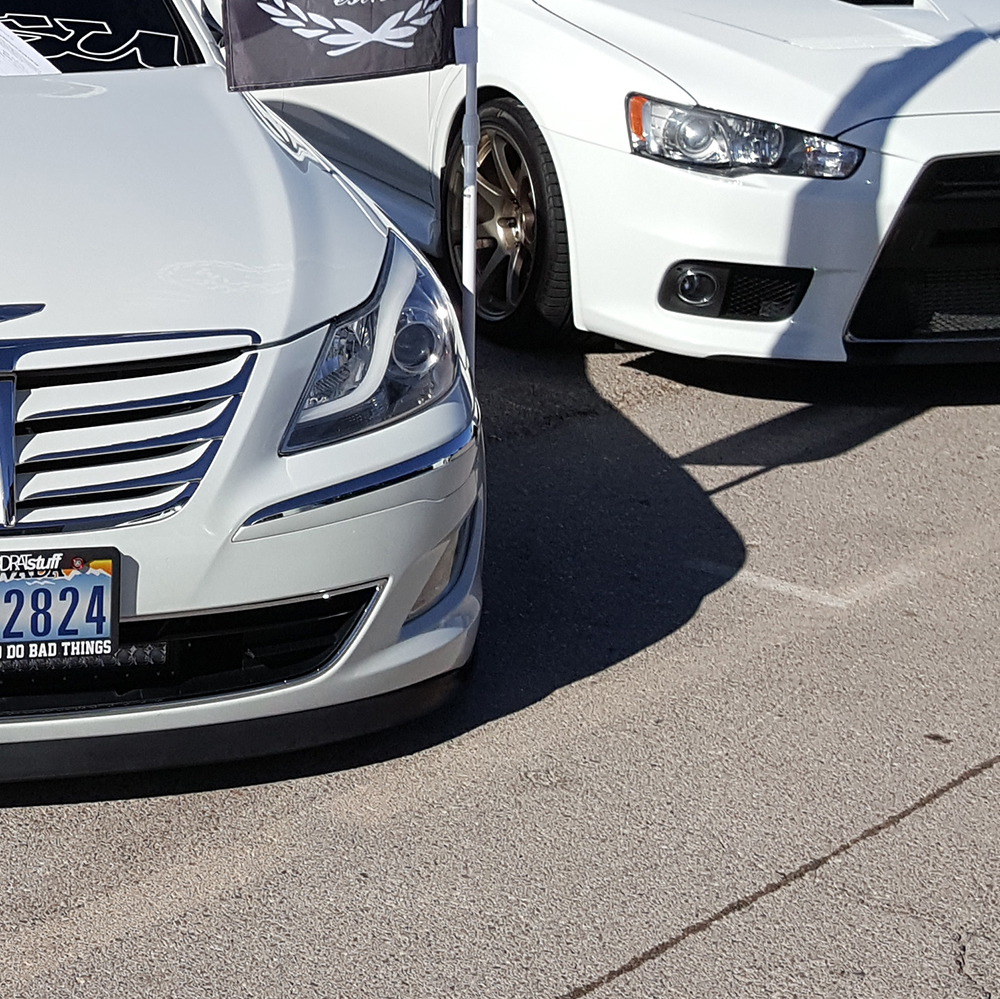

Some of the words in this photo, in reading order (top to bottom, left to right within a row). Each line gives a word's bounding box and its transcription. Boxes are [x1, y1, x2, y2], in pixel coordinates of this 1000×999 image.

[7, 644, 25, 659] DO
[29, 642, 57, 658] BAD
[61, 640, 112, 657] THINGS
